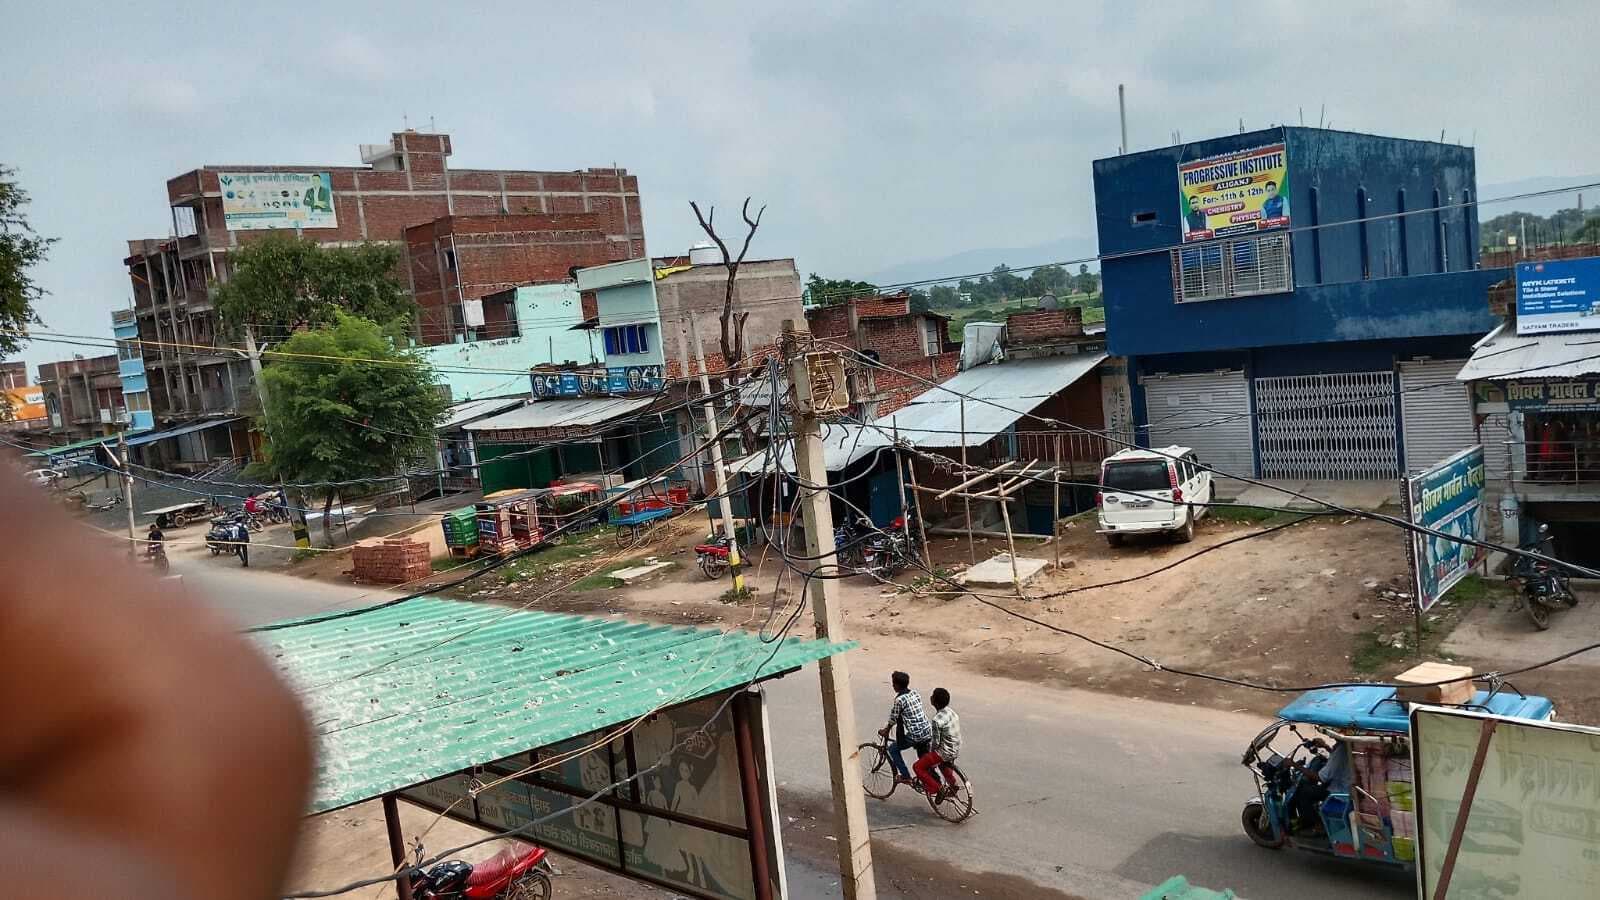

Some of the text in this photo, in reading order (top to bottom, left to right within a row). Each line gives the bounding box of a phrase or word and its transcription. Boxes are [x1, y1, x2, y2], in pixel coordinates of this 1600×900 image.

[1183, 161, 1239, 186] PROGRESSIVE
[1240, 153, 1283, 175] INSTITUTE
[1216, 178, 1250, 190] ALIGANJ
[1220, 192, 1237, 201] 11th
[1239, 190, 1245, 198] &
[1247, 188, 1264, 197] 12th
[1207, 203, 1243, 215] CHEMISTRY
[1231, 212, 1261, 223] PHYSICS
